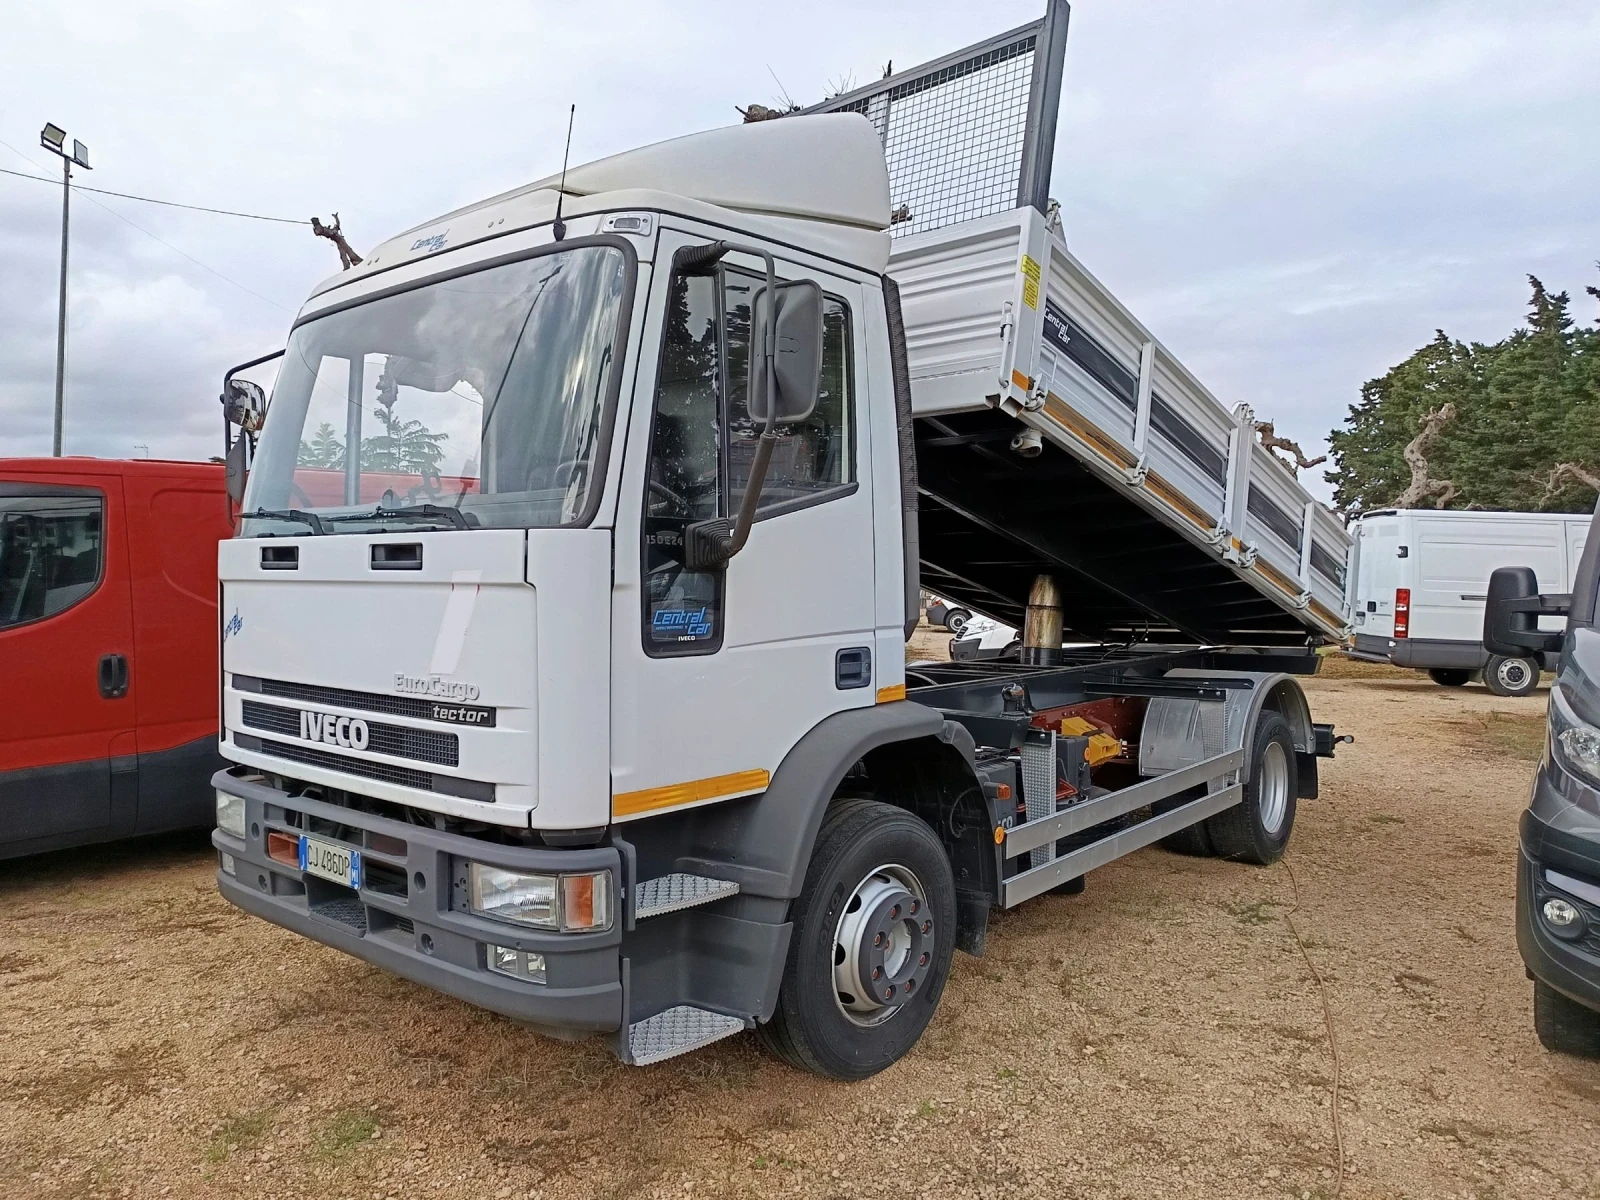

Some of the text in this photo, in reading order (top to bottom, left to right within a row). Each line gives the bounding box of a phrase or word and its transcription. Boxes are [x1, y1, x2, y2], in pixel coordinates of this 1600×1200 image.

[1044, 307, 1069, 335] Central
[653, 606, 706, 625] Central
[394, 673, 480, 702] EuroCargo
[432, 705, 488, 723] tector
[300, 710, 369, 750] IVECO
